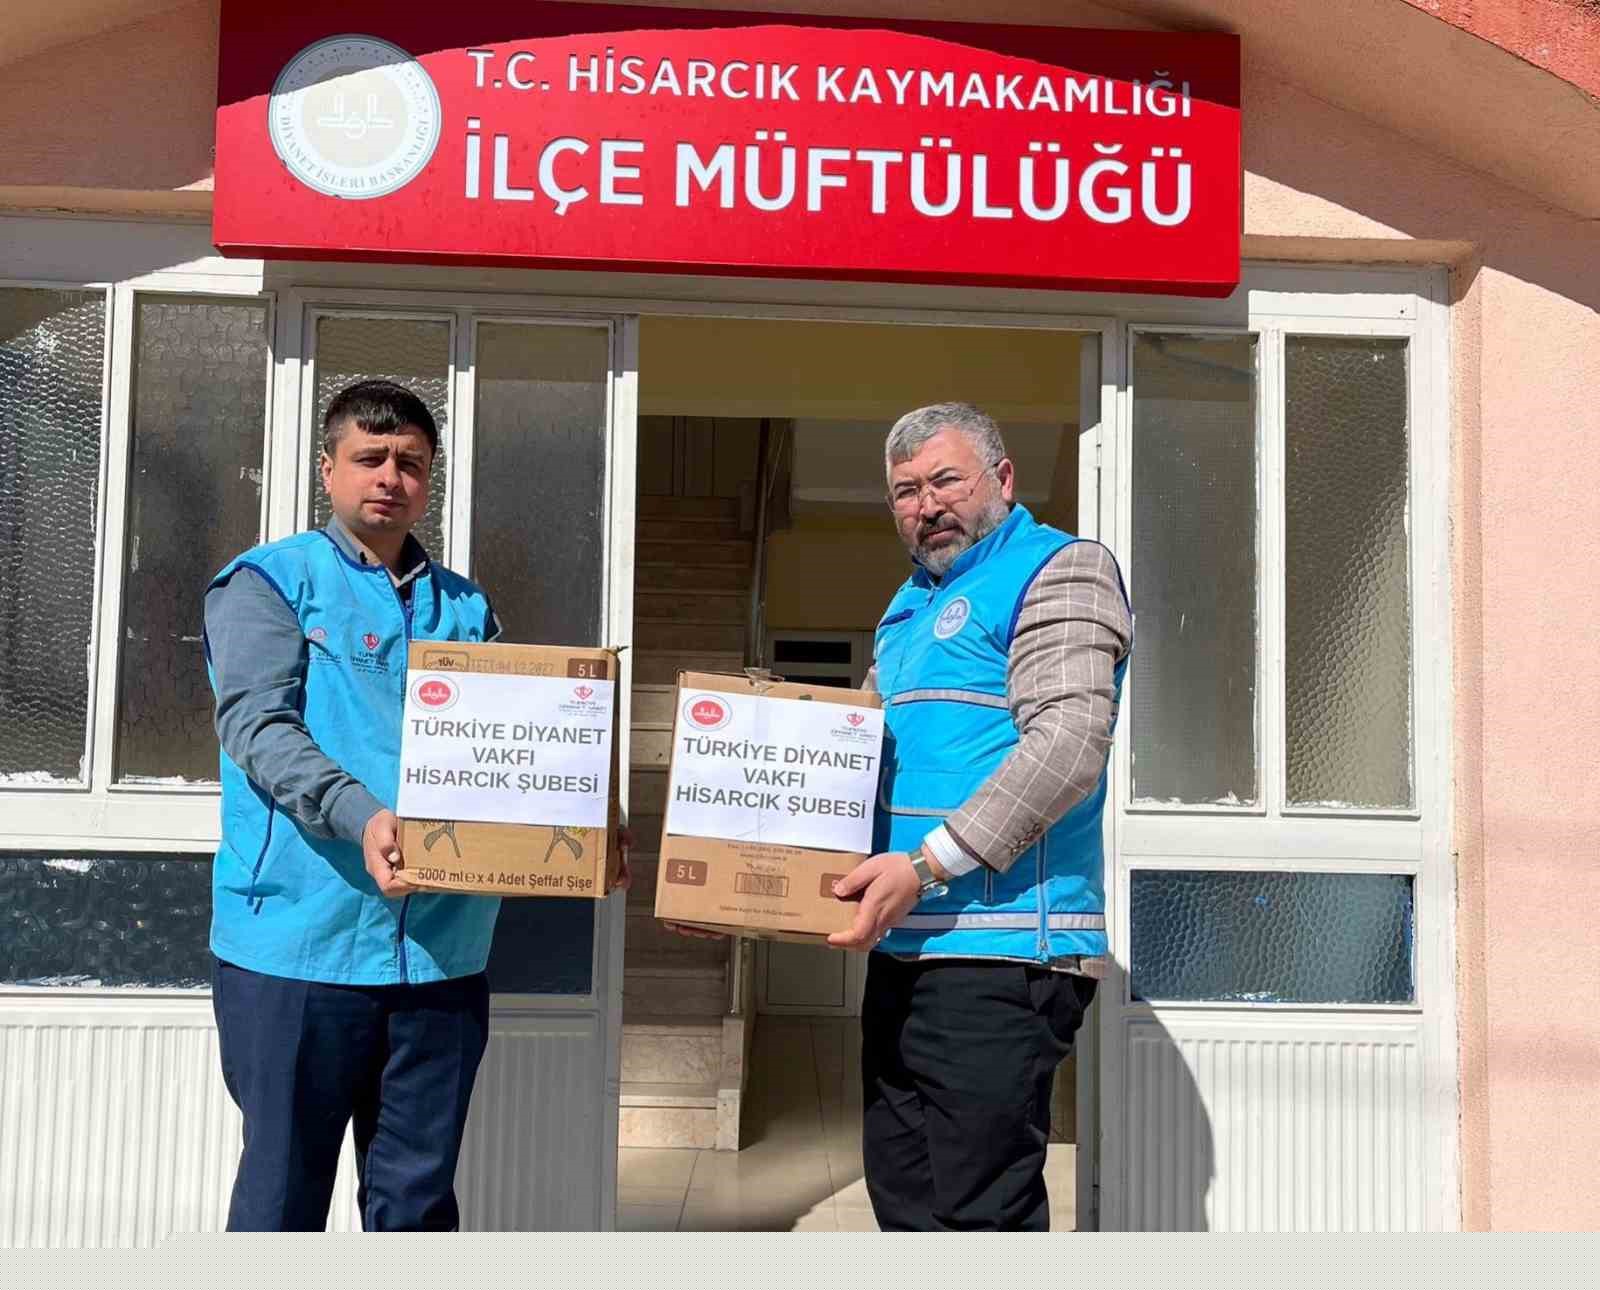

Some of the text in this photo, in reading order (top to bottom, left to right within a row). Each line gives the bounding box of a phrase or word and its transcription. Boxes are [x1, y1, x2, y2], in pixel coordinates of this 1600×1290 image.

[467, 48, 1192, 118] T.C. HİSARCIK KAYMAKAMLIĞI
[465, 117, 1192, 227] İLÇE MÜFTÜLÜĞÜ
[411, 717, 607, 745] TÜRKİYE DİYANET
[472, 747, 535, 766] VAKFI
[683, 736, 876, 772] TÜRKİYE DİYANET
[406, 765, 599, 794] HİSARCIK ŞUBESİ
[743, 767, 806, 788] VAKFI
[676, 783, 866, 819] HİSARCIK ŞUBESİ
[417, 867, 446, 882] 5000
[487, 873, 494, 883] 4
[497, 872, 525, 886] Adet
[528, 874, 564, 888] Şeffaf
[566, 875, 593, 891] Şişe
